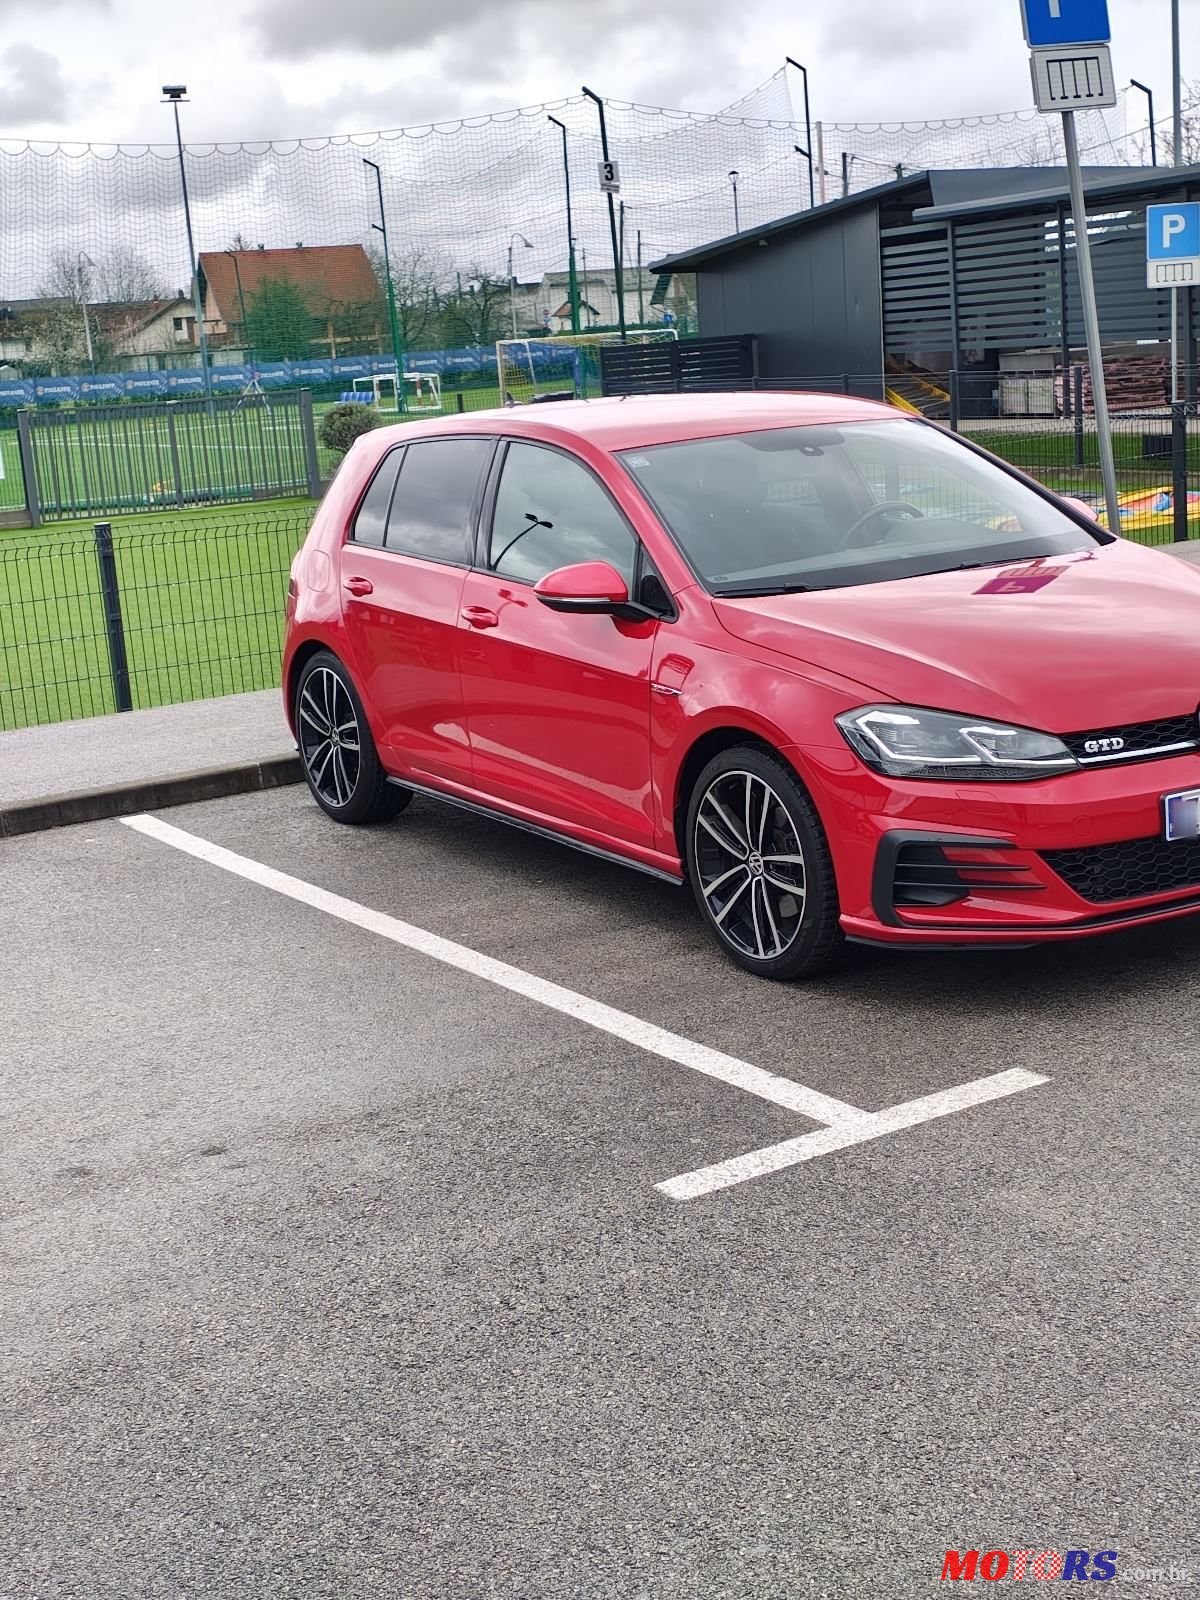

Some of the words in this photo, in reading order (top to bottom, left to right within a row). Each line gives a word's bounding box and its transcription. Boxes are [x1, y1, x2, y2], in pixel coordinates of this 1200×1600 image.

[604, 163, 614, 181] 3
[1162, 214, 1186, 248] P
[1084, 737, 1124, 753] GTD
